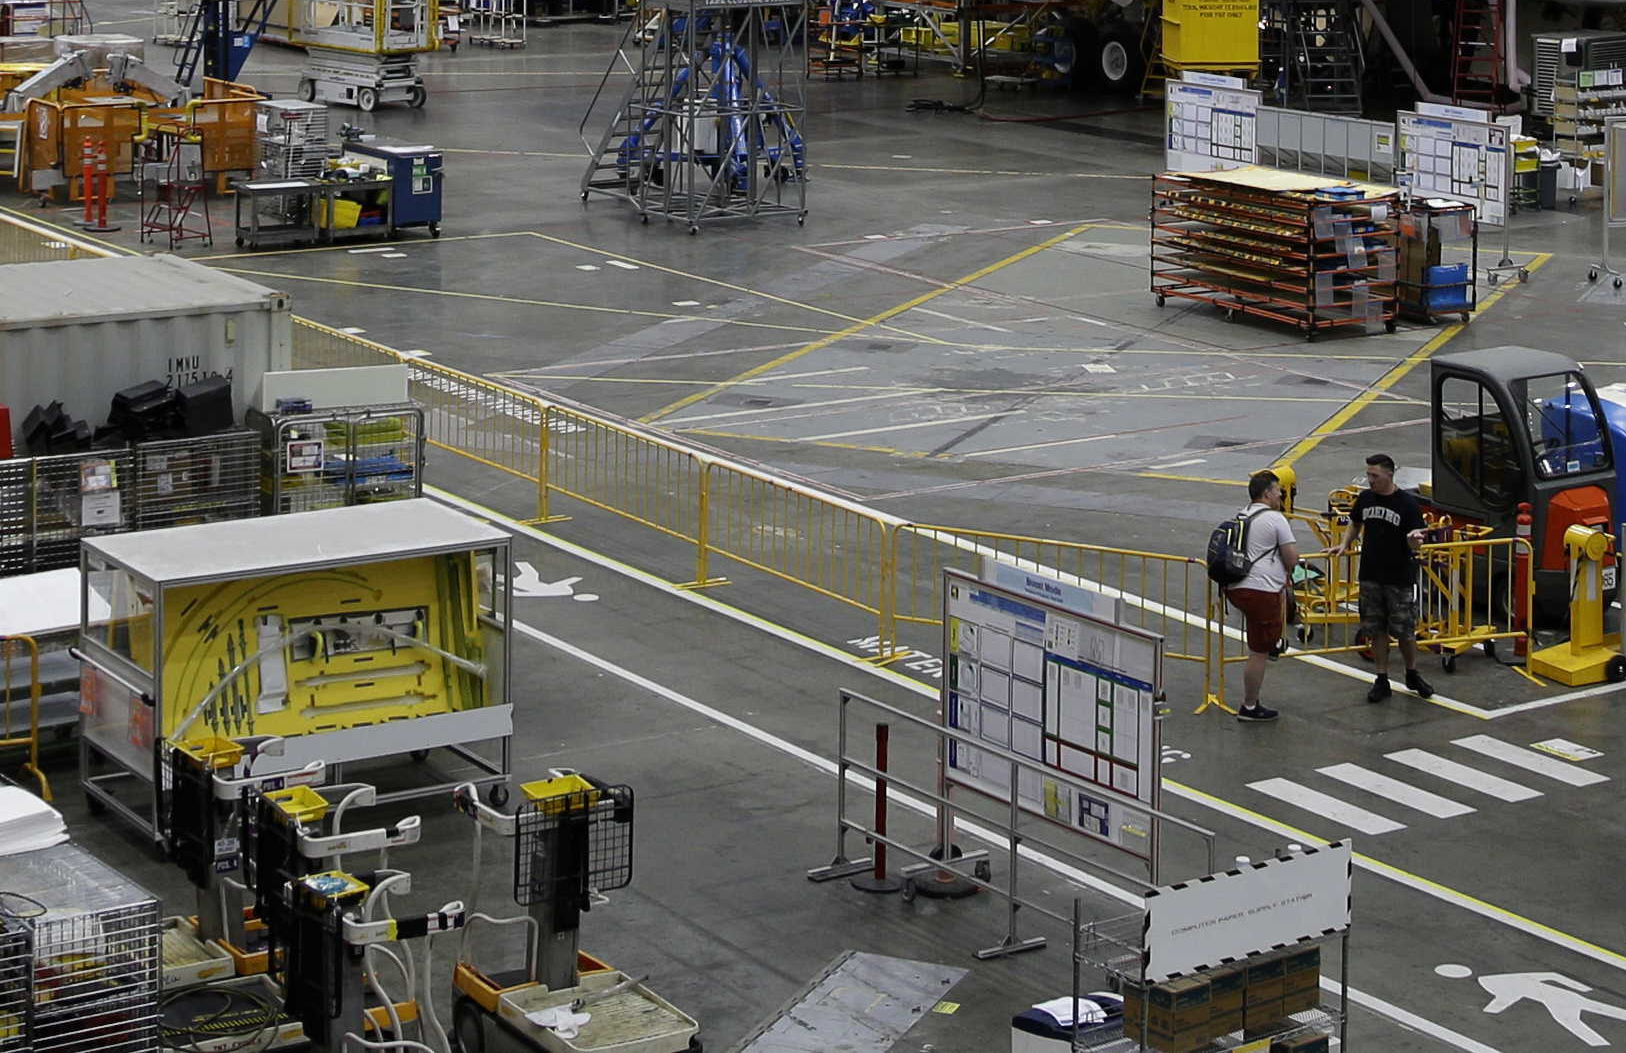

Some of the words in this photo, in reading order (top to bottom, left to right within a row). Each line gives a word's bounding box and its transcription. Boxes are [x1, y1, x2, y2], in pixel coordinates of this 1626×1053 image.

[1362, 506, 1401, 526] BOEING
[1171, 918, 1217, 935] COMPUTER
[1218, 911, 1244, 924] PAPER
[1247, 903, 1277, 916] SUPPLY
[1281, 893, 1313, 906] STATION
